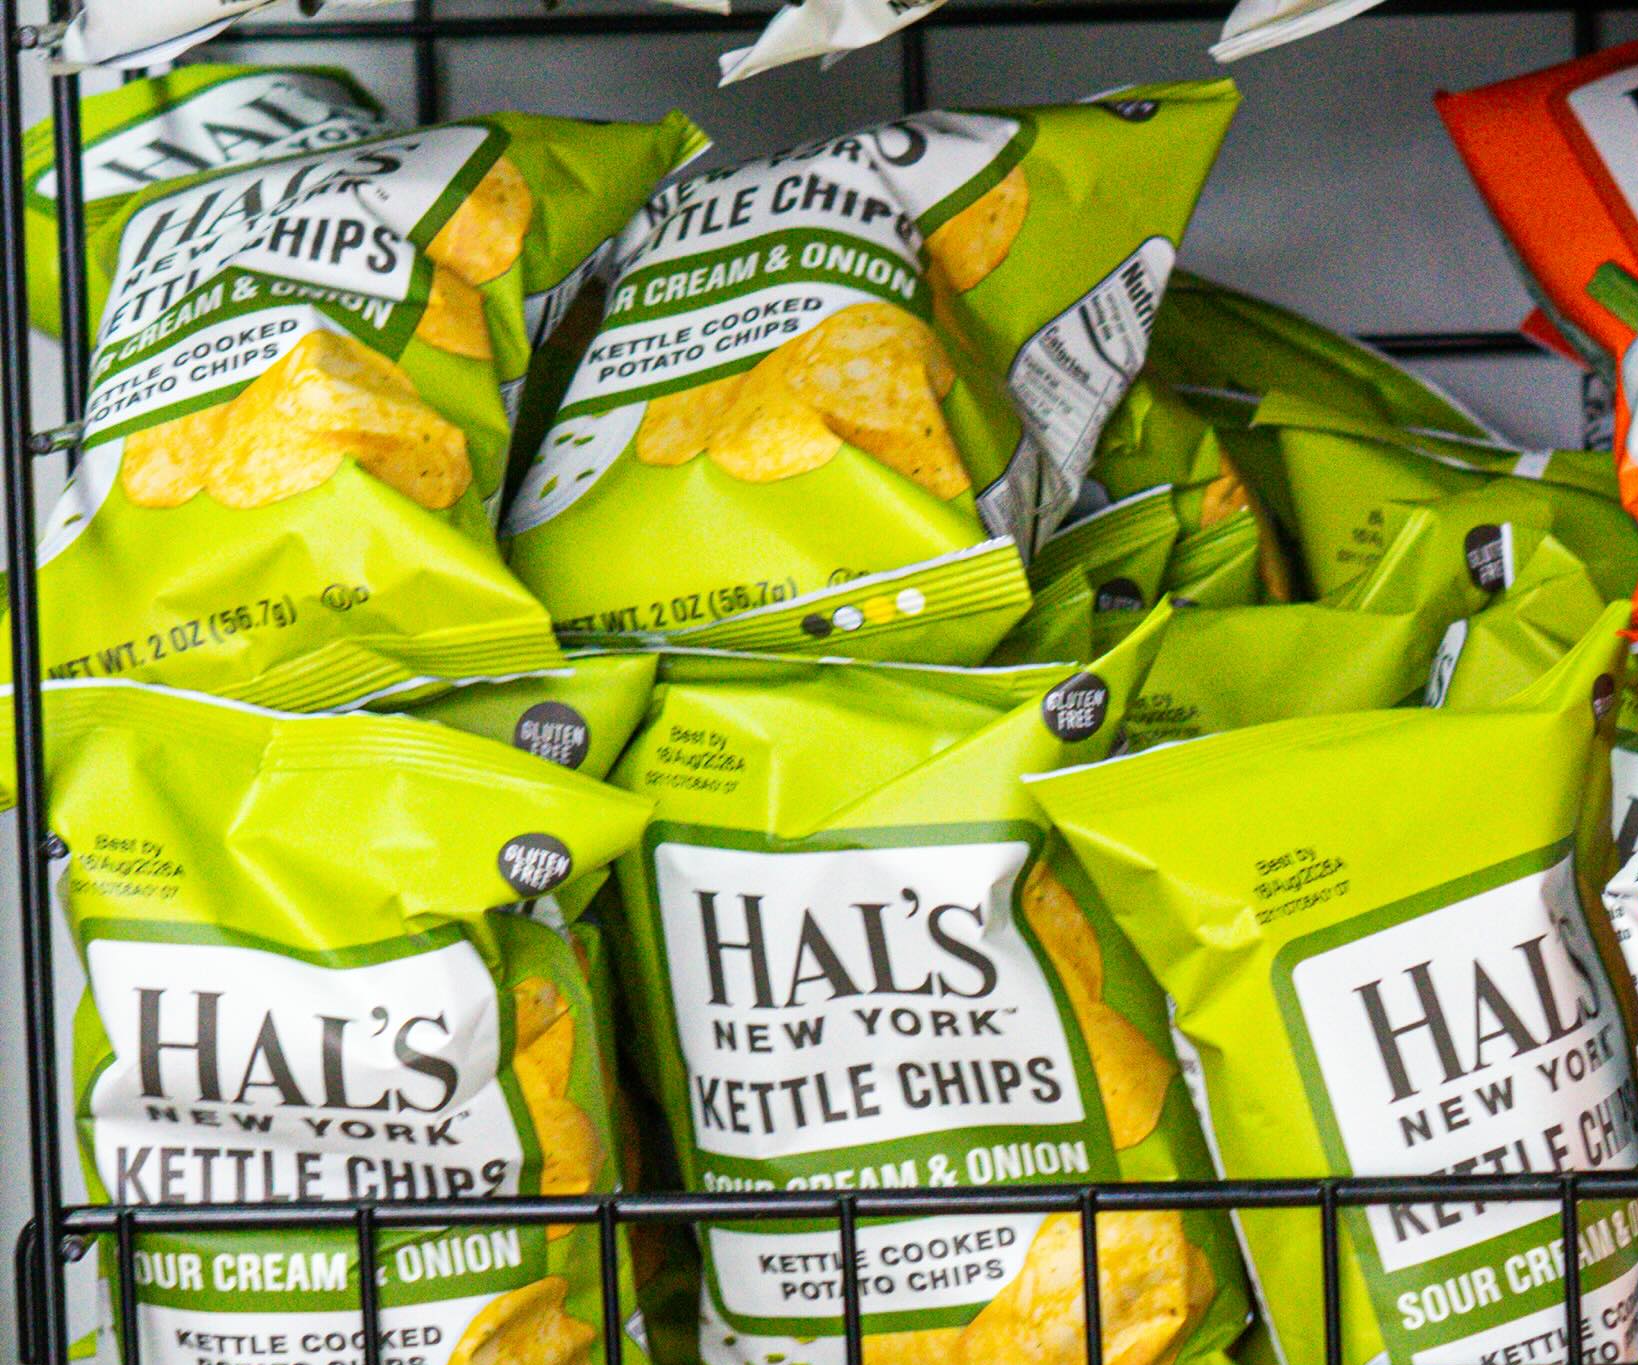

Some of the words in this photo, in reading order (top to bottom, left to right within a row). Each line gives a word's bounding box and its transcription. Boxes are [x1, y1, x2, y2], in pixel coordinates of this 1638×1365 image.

[646, 250, 757, 308] CREAM
[801, 240, 917, 300] ONION
[587, 320, 693, 365] KETTLE
[700, 294, 826, 339] COOKED
[599, 345, 706, 384] POTATO
[715, 315, 801, 356] CHIPS
[97, 643, 141, 676] WT.
[149, 627, 164, 659] 2
[169, 617, 203, 651] OZ
[209, 594, 297, 648] (56.7g)
[693, 887, 1000, 1010] HAL'S
[133, 987, 462, 1114] HAL'S
[713, 1017, 826, 1054] NEW
[852, 1007, 1004, 1037] YORK
[146, 1103, 274, 1134] NEW
[302, 1117, 462, 1147] YORK
[696, 1060, 882, 1136] KETTLE
[899, 1055, 1063, 1109] CHIPS
[1399, 1077, 1514, 1147] NEW
[966, 1141, 1090, 1182] ONION
[213, 1252, 347, 1293] CREAM
[396, 1228, 523, 1285] ONION
[879, 1227, 1017, 1266] COOKED
[907, 1259, 1005, 1292] CHIPS
[1396, 1262, 1503, 1331] SOUR
[176, 1328, 288, 1356] KETTLE
